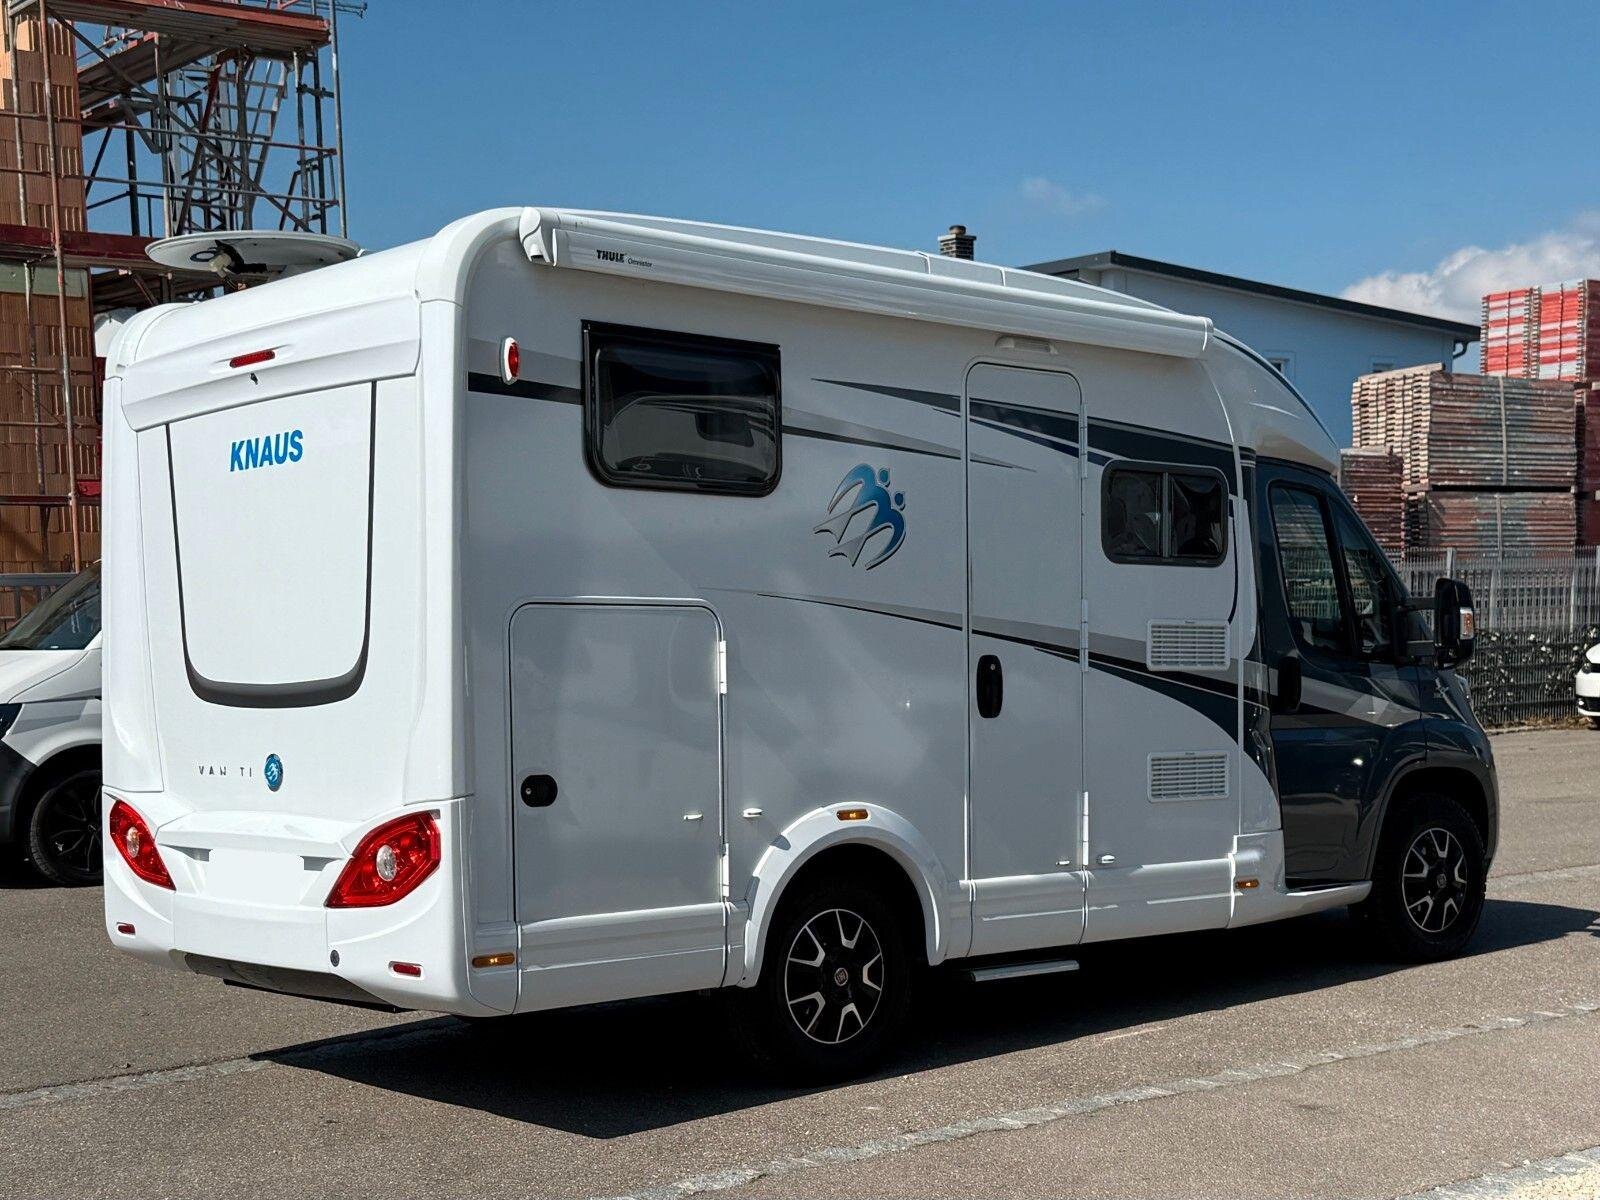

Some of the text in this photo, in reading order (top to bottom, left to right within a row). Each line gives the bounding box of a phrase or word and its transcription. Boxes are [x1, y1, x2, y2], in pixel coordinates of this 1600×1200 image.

[596, 249, 625, 263] THULE
[230, 429, 303, 472] KNAUS
[198, 765, 252, 777] VAN TI
